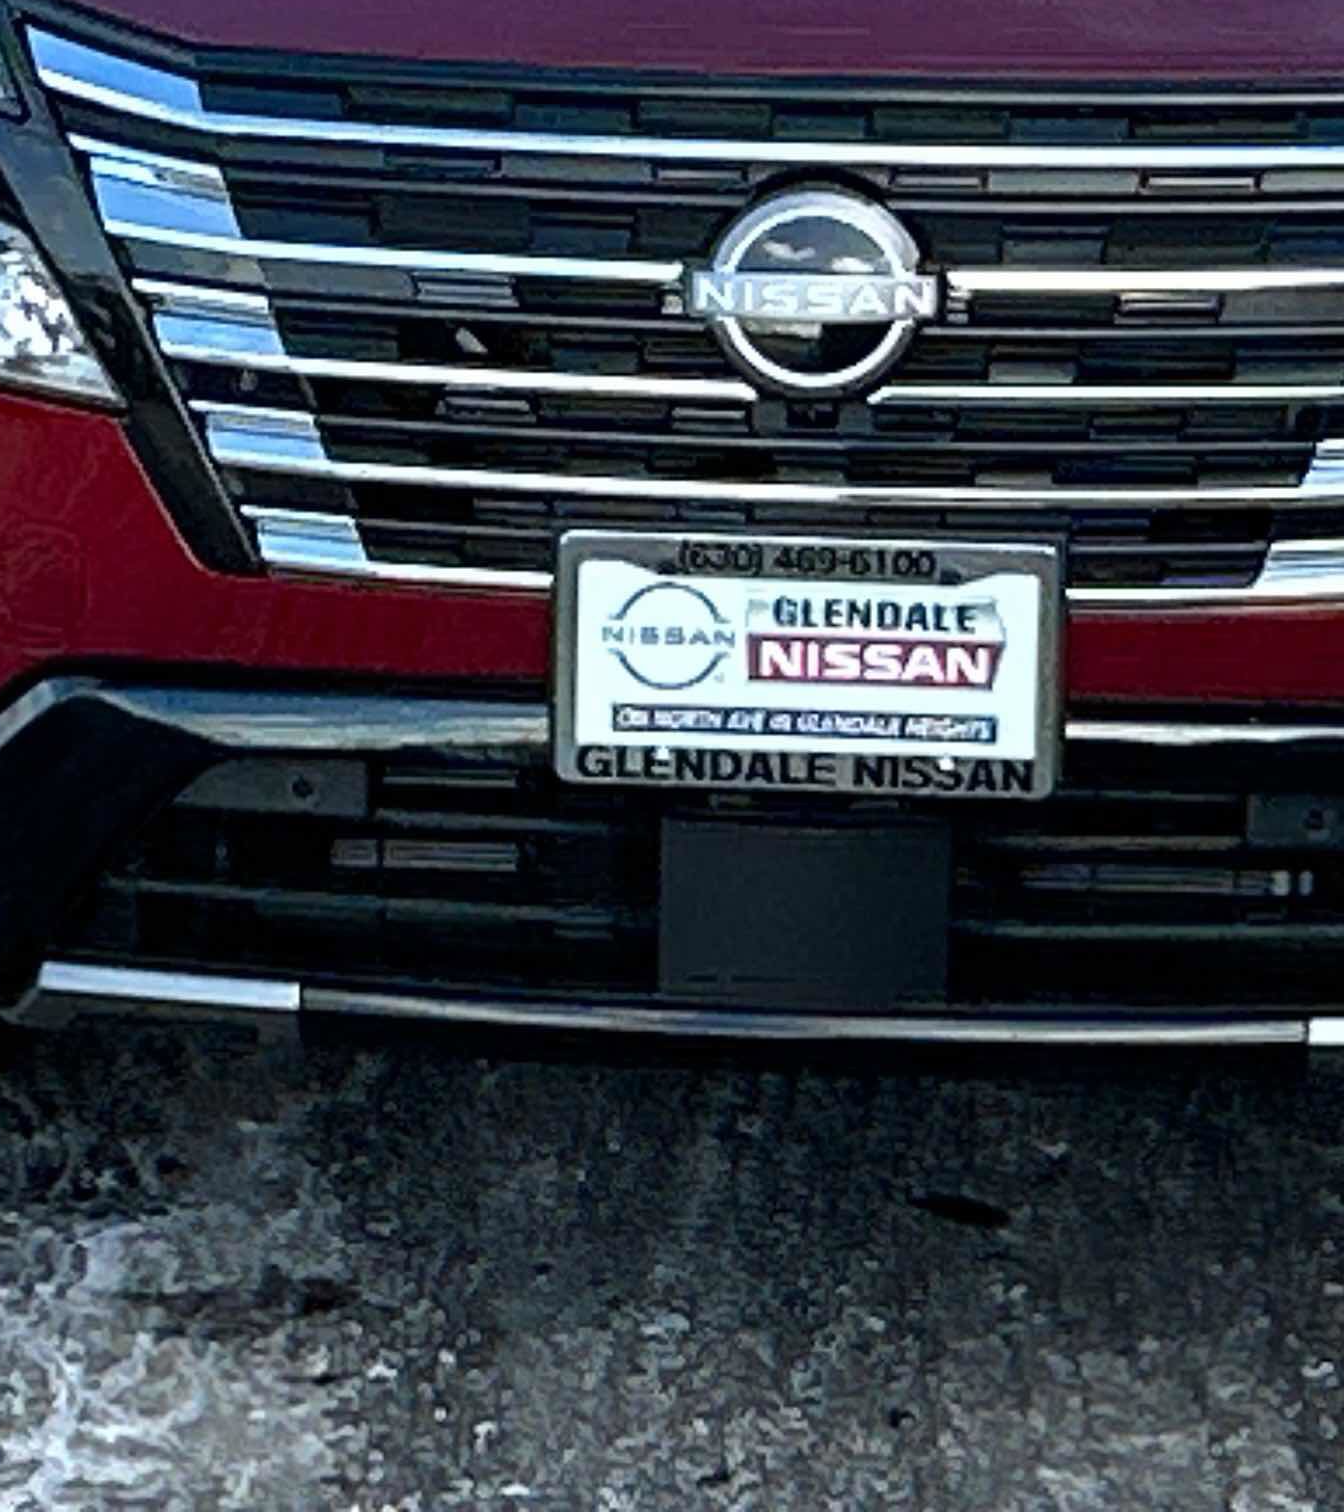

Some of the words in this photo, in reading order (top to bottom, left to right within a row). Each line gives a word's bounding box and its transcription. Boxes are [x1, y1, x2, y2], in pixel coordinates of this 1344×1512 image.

[695, 276, 936, 317] NISSAN
[677, 539, 763, 577] (630)
[773, 545, 936, 577] 469-6100
[772, 595, 977, 635] GLENDALE
[601, 626, 735, 648] NISSAN
[759, 640, 991, 685] NISSAN
[575, 745, 837, 785] GLENDALE
[853, 755, 1035, 793] NISSAN
